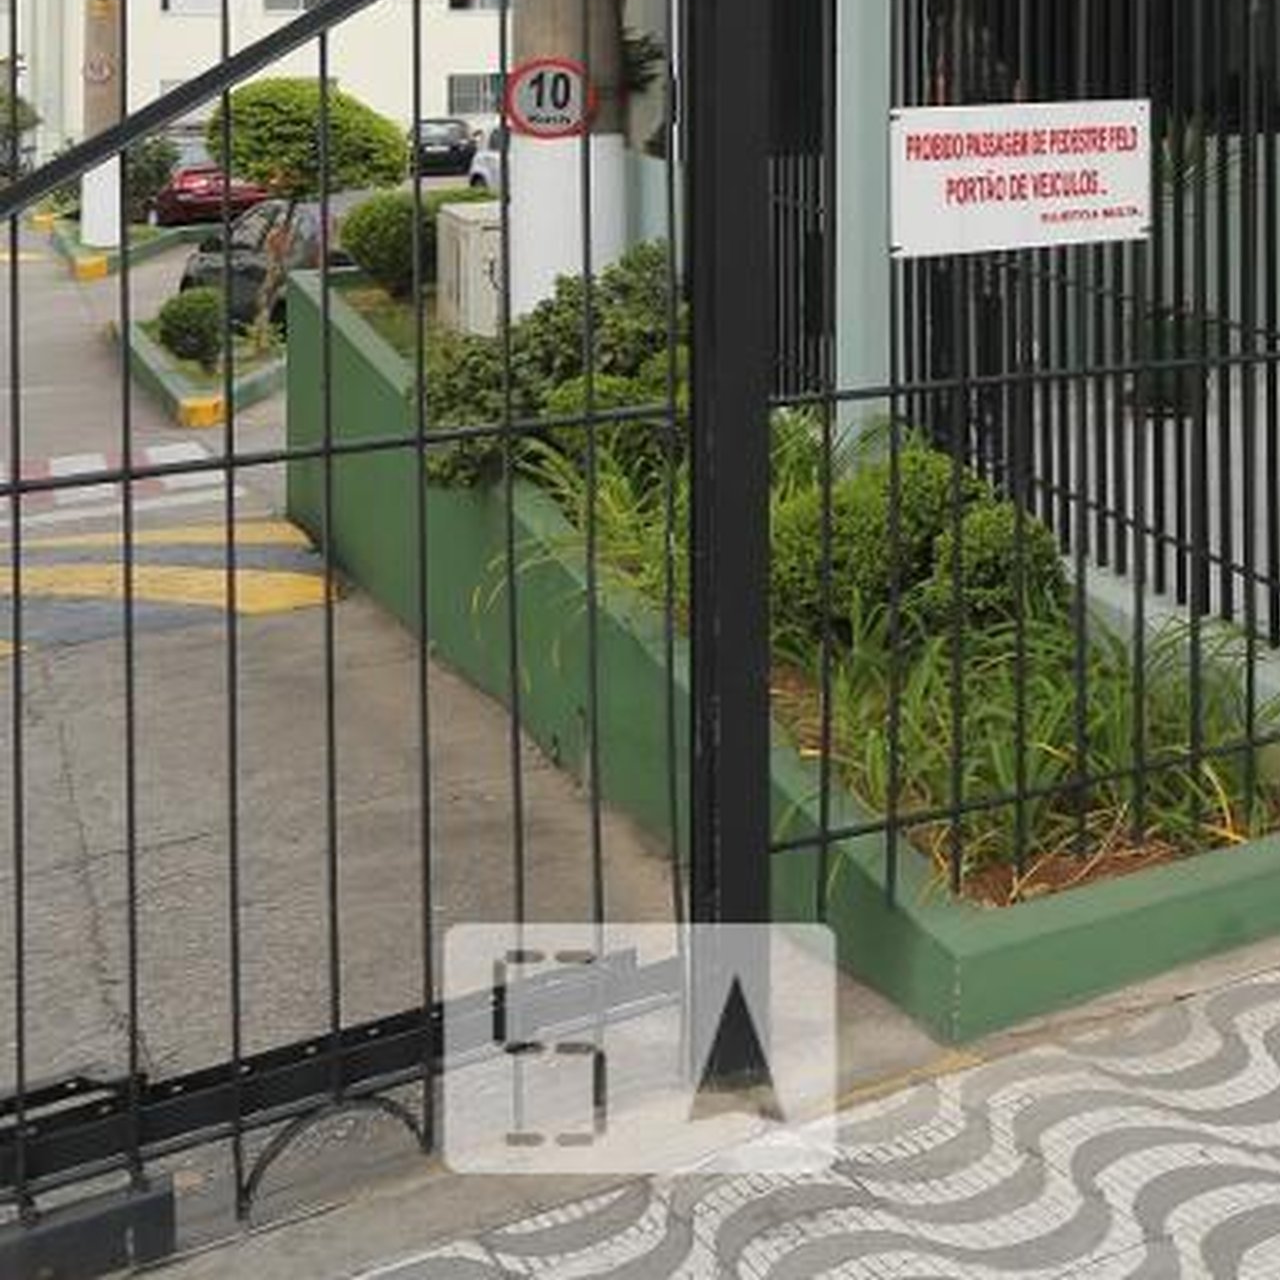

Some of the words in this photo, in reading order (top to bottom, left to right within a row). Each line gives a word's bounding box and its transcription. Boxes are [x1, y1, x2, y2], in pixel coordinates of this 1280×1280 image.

[529, 72, 570, 109] 10
[906, 132, 964, 160] PROIBIDO
[966, 128, 1028, 157] PASSAGEM
[1032, 128, 1047, 154] DE
[1010, 172, 1028, 200] DE
